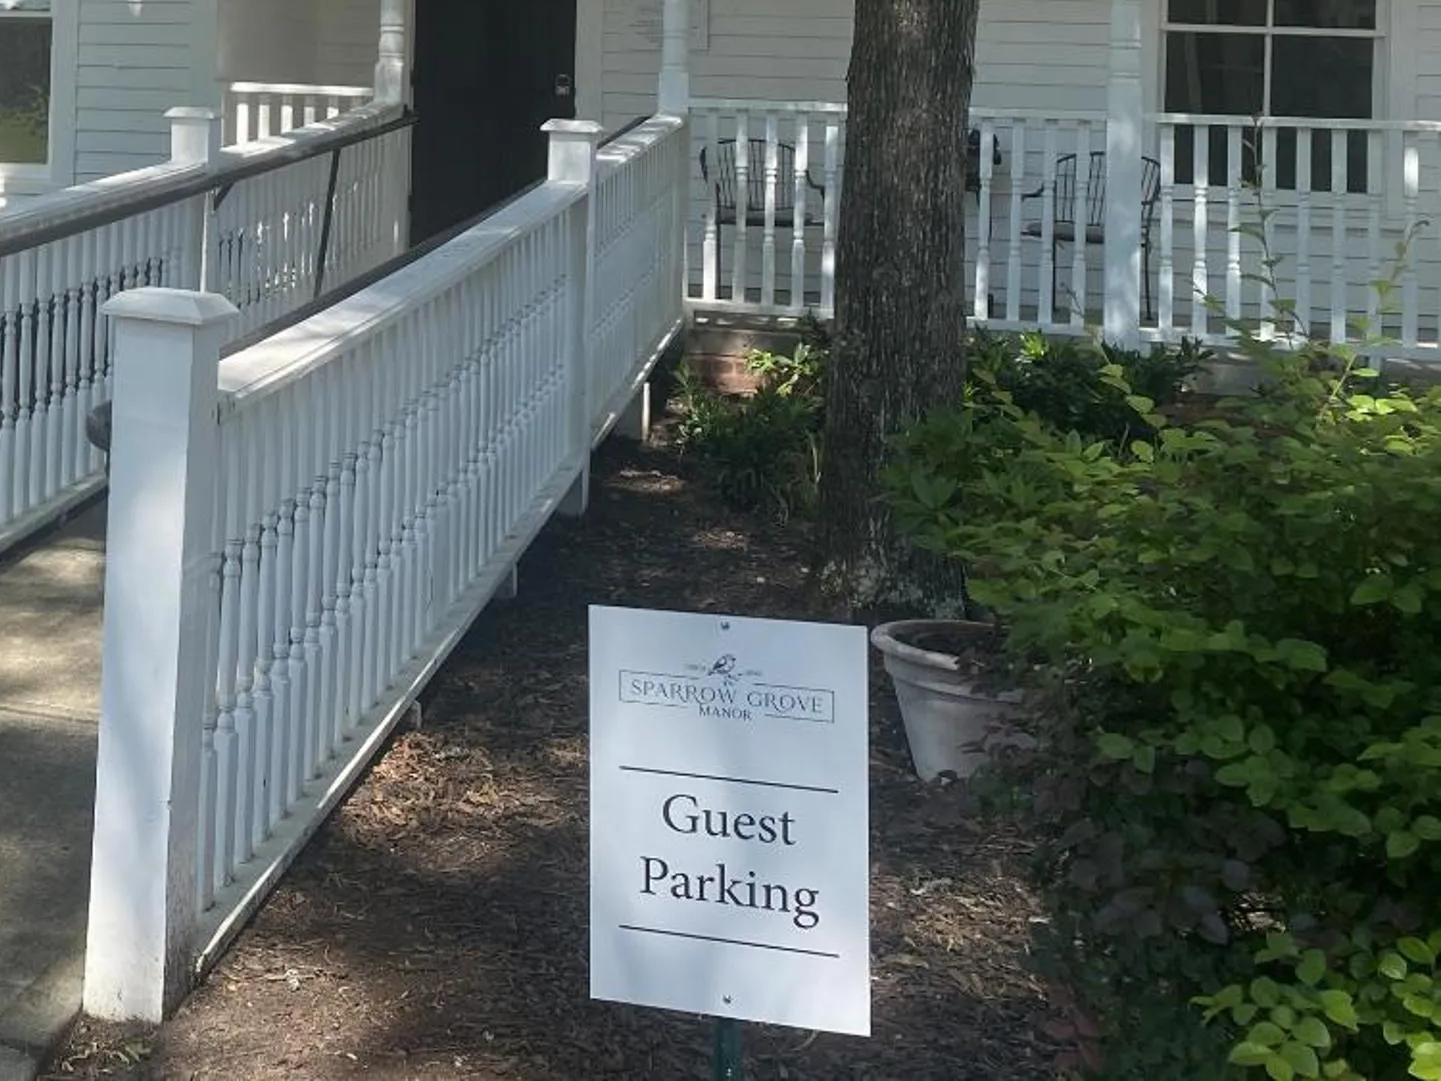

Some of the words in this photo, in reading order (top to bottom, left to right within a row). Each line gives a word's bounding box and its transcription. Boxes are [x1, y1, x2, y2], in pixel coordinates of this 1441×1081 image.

[631, 679, 737, 704] SPARROW
[747, 690, 824, 714] GROVE
[698, 704, 753, 721] MANOR
[662, 793, 796, 846] Guest
[640, 856, 820, 930] Parking
